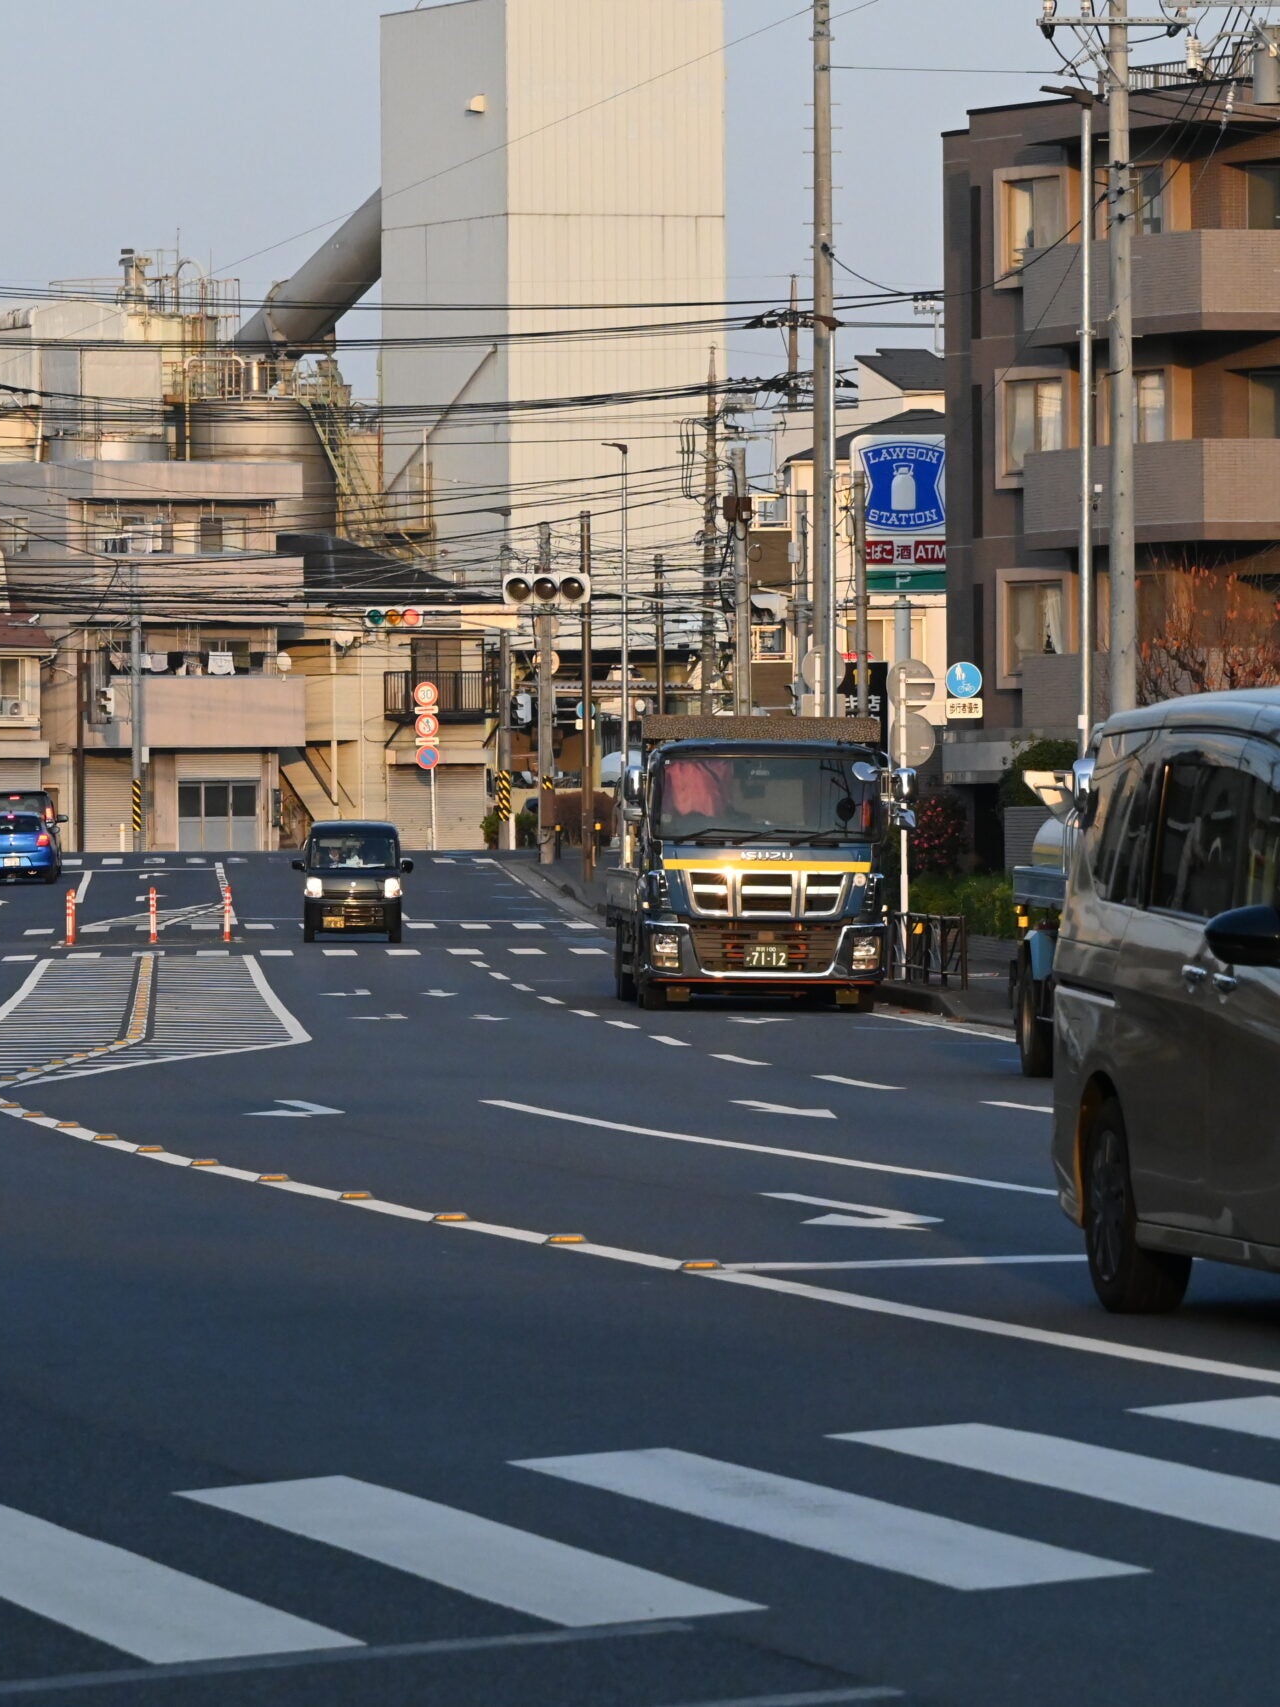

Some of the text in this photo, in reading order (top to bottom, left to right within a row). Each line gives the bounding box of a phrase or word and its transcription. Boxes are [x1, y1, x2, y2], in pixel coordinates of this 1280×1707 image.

[868, 447, 940, 464] LAWSON
[868, 508, 938, 525] STATION
[896, 545, 912, 559] 酒
[896, 571, 911, 588] P
[420, 688, 432, 700] 30
[949, 702, 980, 715] 歩行者優先
[740, 851, 795, 861] ISUZU
[751, 952, 786, 966] 71-12
